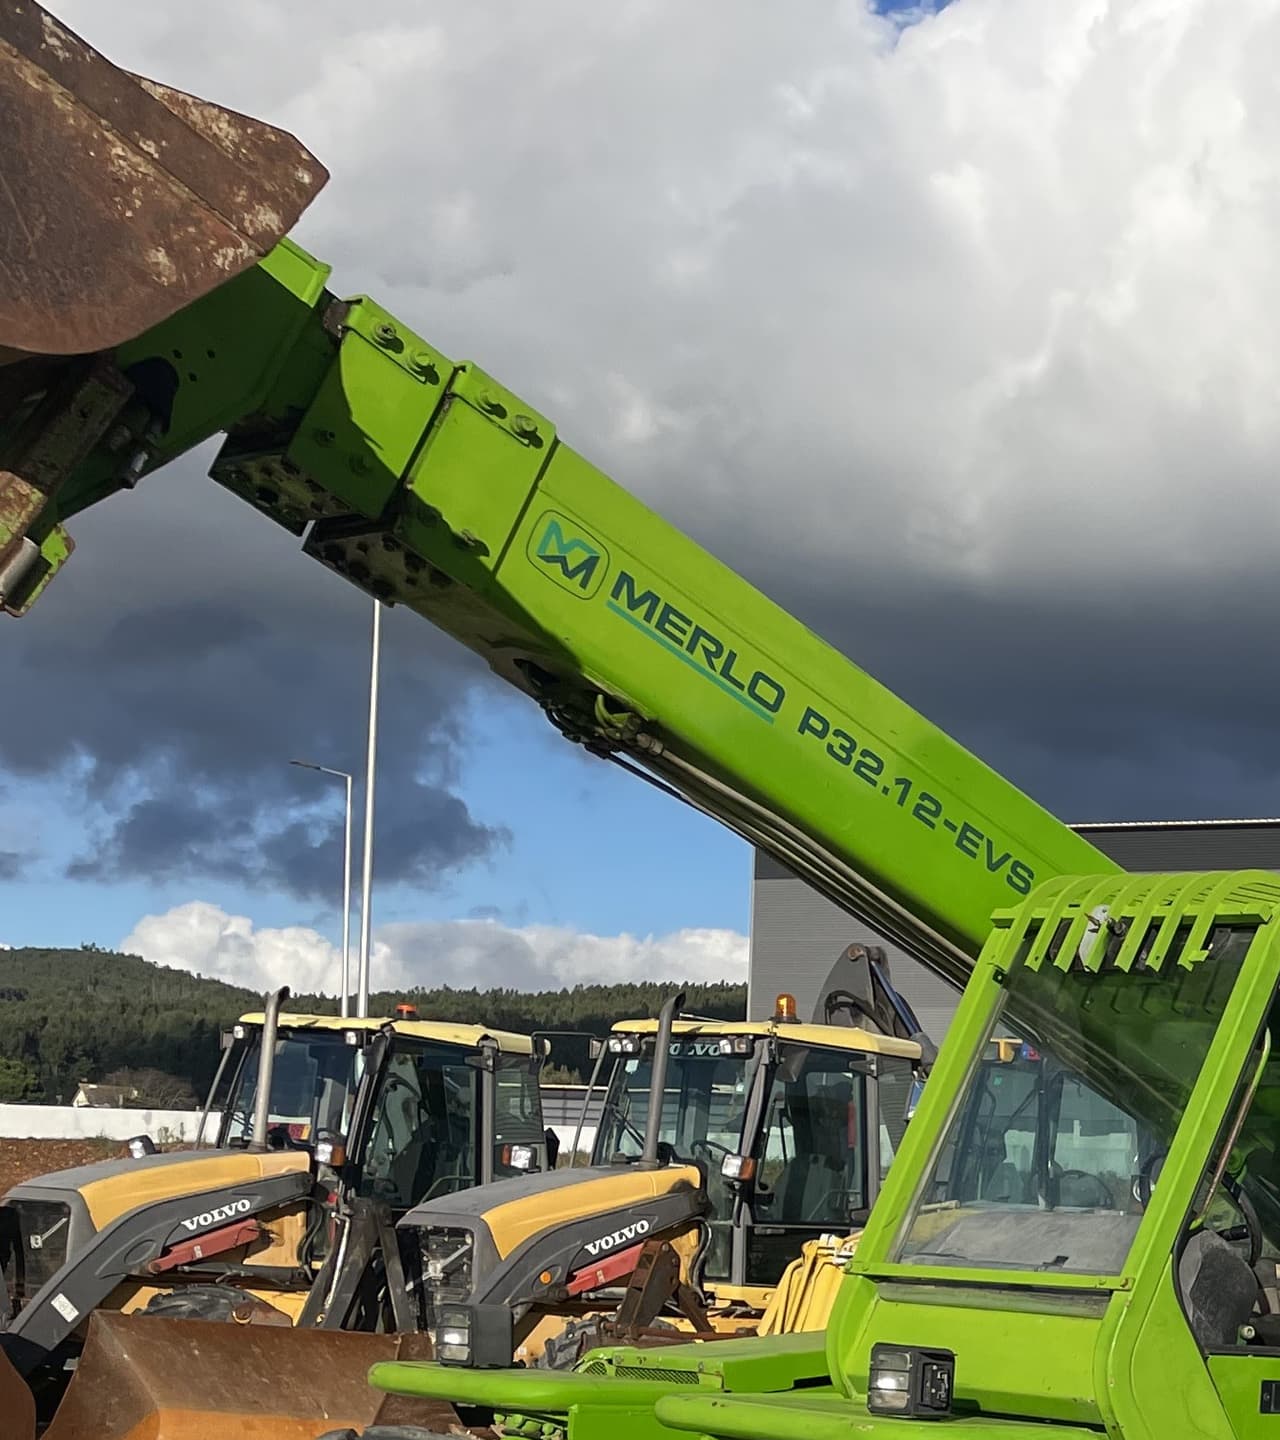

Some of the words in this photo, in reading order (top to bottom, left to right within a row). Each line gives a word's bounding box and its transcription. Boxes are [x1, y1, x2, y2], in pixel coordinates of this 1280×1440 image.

[610, 570, 786, 713] MERLO
[799, 706, 1035, 896] P32.12-EVS
[667, 1042, 721, 1056] OVO
[181, 1199, 250, 1230] VOLVO
[584, 1219, 650, 1255] VOLVO
